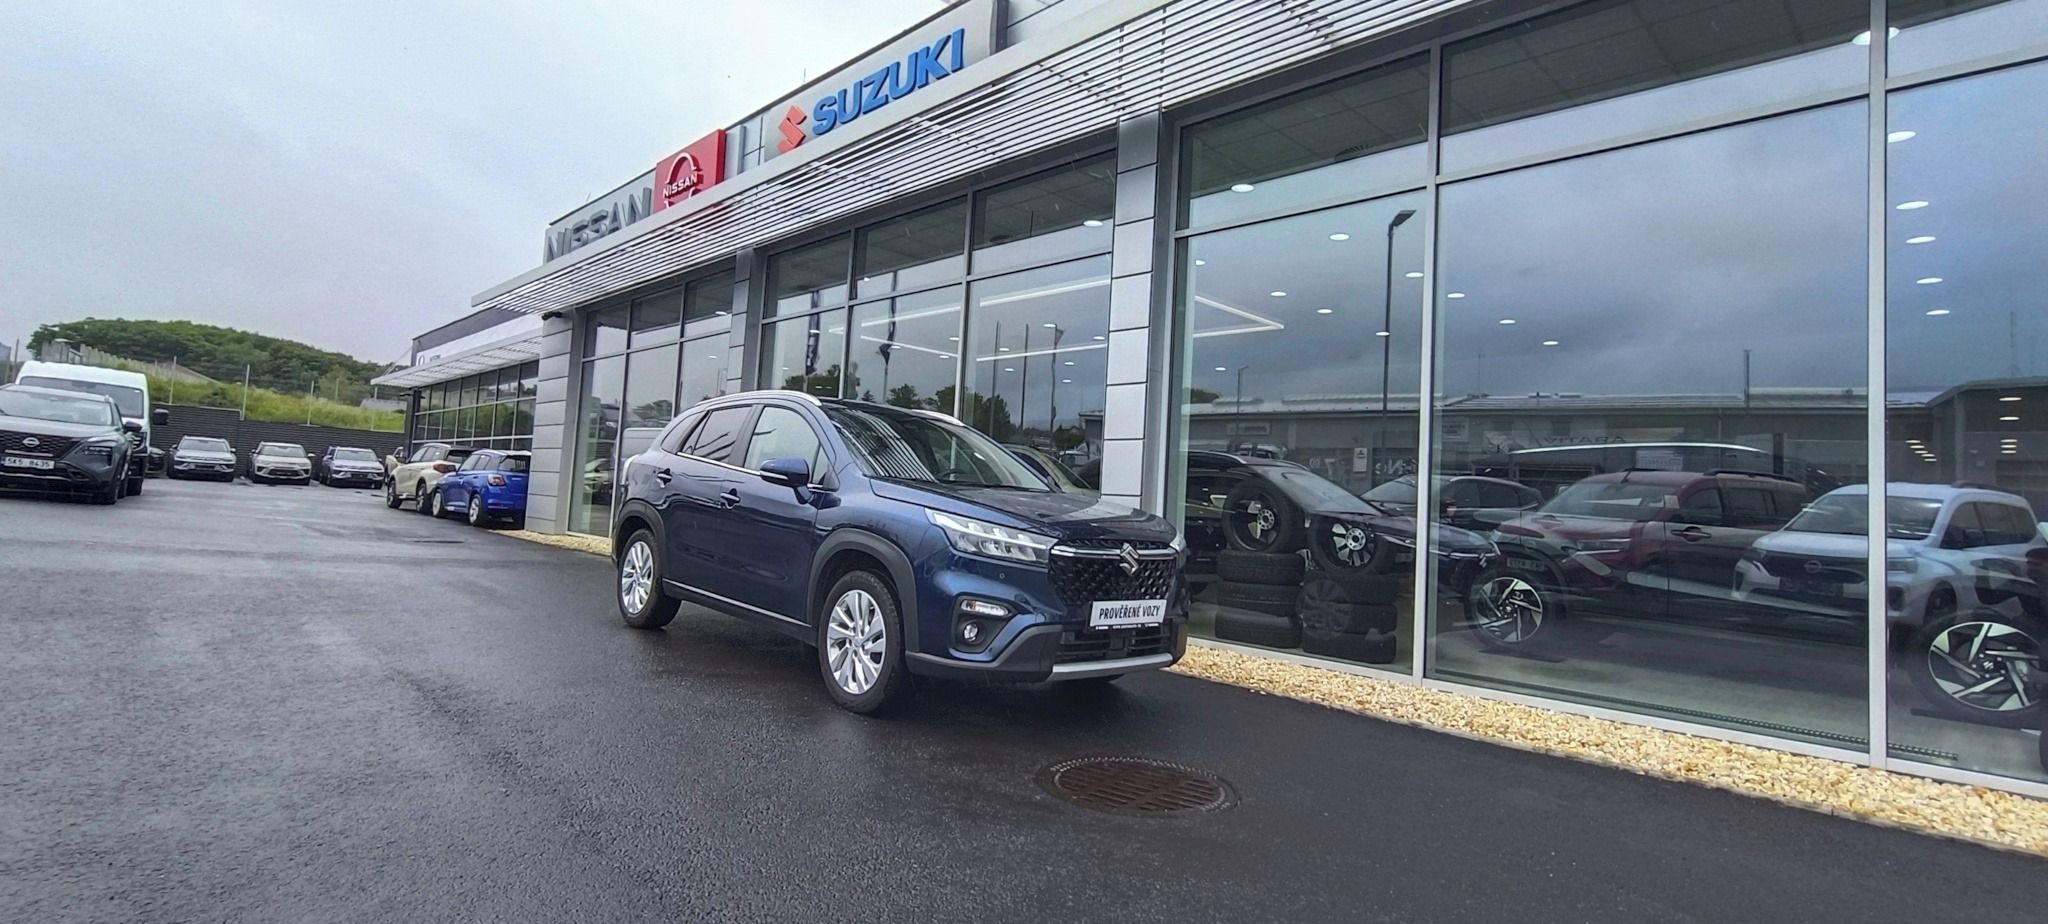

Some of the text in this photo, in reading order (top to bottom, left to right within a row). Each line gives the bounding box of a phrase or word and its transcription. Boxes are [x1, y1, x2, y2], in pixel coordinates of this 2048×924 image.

[812, 28, 965, 136] SUZUKI
[662, 171, 699, 197] NISSAN
[545, 187, 653, 263] NISSAN
[1099, 604, 1160, 620] PROVĚŘENÉ VOZY
